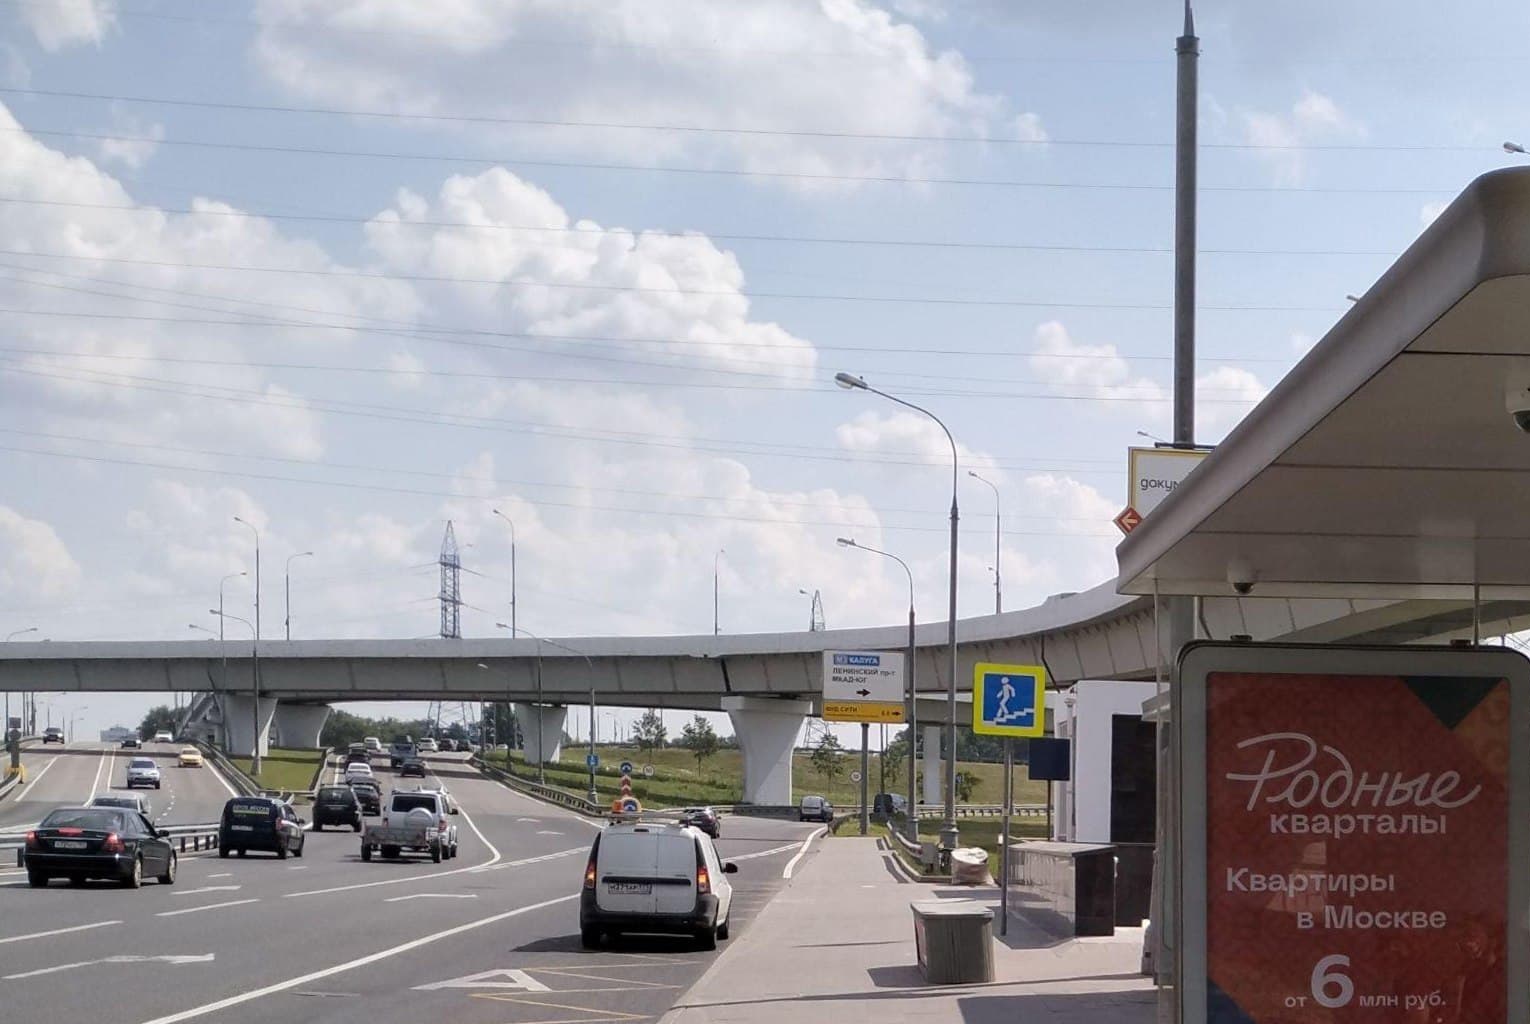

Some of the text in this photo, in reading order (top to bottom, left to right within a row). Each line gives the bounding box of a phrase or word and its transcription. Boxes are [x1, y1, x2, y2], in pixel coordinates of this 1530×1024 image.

[832, 668, 879, 676] ЛЕНИНСКИЙ
[848, 656, 878, 665] КАЛУГА
[1226, 732, 1483, 811] Родные
[1270, 811, 1447, 839] кварталы
[1226, 867, 1396, 898] Квартиры
[1297, 905, 1448, 930] в Москве
[1285, 953, 1447, 1010] от 6 млн руб.
